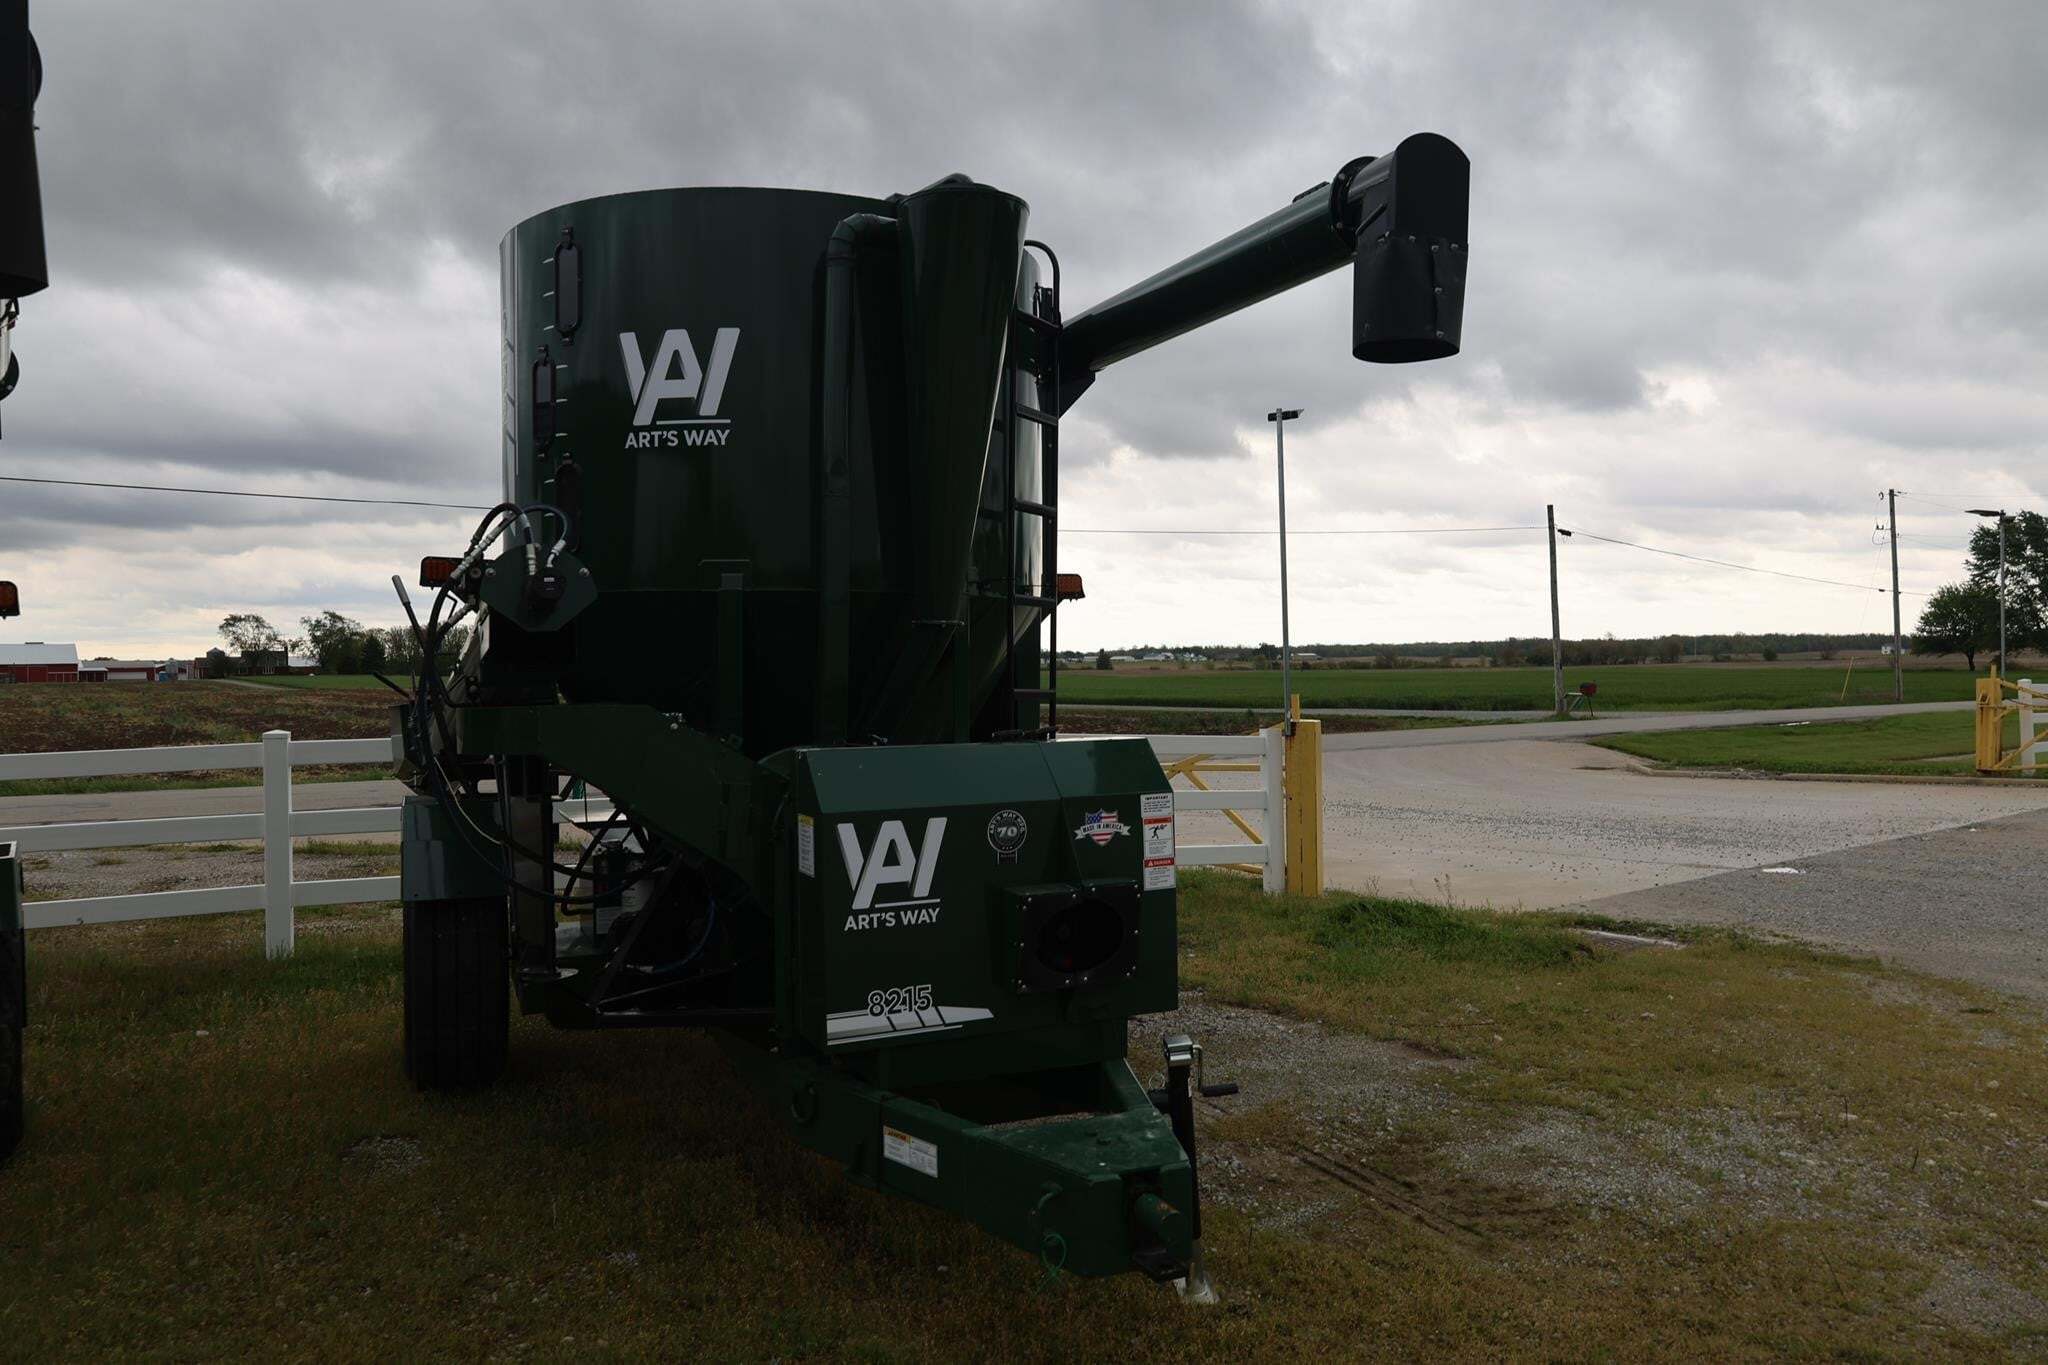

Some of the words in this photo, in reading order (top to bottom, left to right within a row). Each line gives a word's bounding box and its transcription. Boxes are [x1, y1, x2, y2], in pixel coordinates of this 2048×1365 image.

[624, 430, 679, 449] ART'S
[683, 429, 731, 447] WAY
[997, 826, 1018, 838] 70
[1082, 824, 1095, 833] MADE
[844, 911, 896, 931] ART'S
[900, 907, 941, 926] WAY
[867, 983, 933, 1017] 8215
